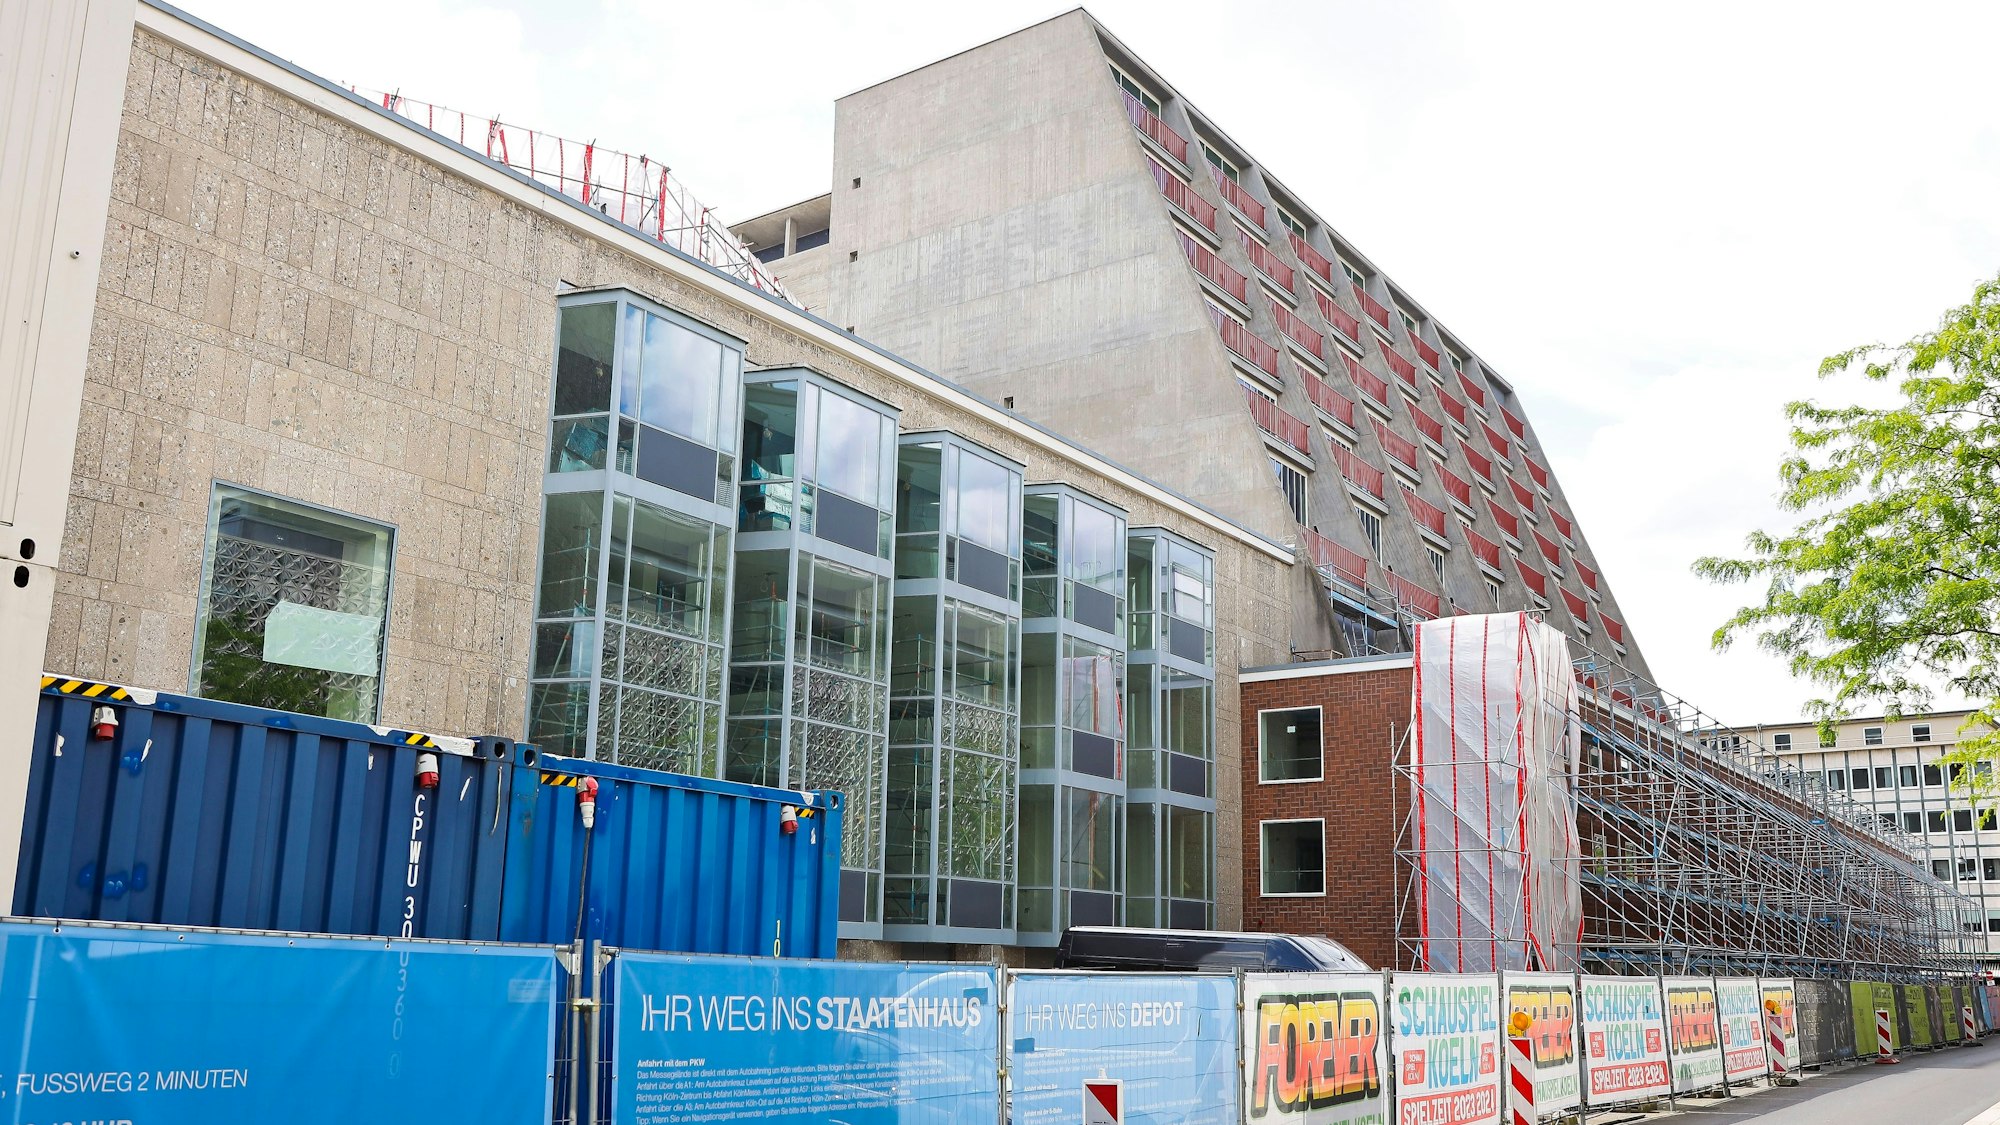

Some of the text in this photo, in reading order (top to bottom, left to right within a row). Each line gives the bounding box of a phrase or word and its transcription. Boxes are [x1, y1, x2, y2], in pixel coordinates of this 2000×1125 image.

[406, 795, 426, 887] CPWU
[641, 994, 982, 1032] IHR WEG INS STAATENHAUS
[1024, 1001, 1184, 1032] IHR WEG INS DEPOT
[1399, 986, 1496, 1037] SCHAUSPIEL
[1585, 984, 1660, 1022] SCHAUSPIEL
[1251, 992, 1380, 1118] FOREVER
[1606, 1023, 1646, 1062] KOELN
[637, 1058, 706, 1068] Anfahrt mit dem PKW
[637, 1071, 649, 1079] Das
[700, 1069, 716, 1078] direkt
[1428, 1036, 1479, 1089] KOELN
[1594, 1064, 1665, 1092] SPIELZEIT 2023 2024
[15, 1071, 133, 1096] FUSSWEG
[137, 1071, 150, 1092] 2
[155, 1068, 248, 1091] MINUTEN
[636, 1094, 662, 1103] Richtung
[703, 1091, 712, 1099] bis
[637, 1082, 658, 1090] Anfahrt
[636, 1105, 657, 1113] Anfahrt
[1403, 1096, 1452, 1125] SPIELZEIT
[1453, 1092, 1476, 1121] 2023
